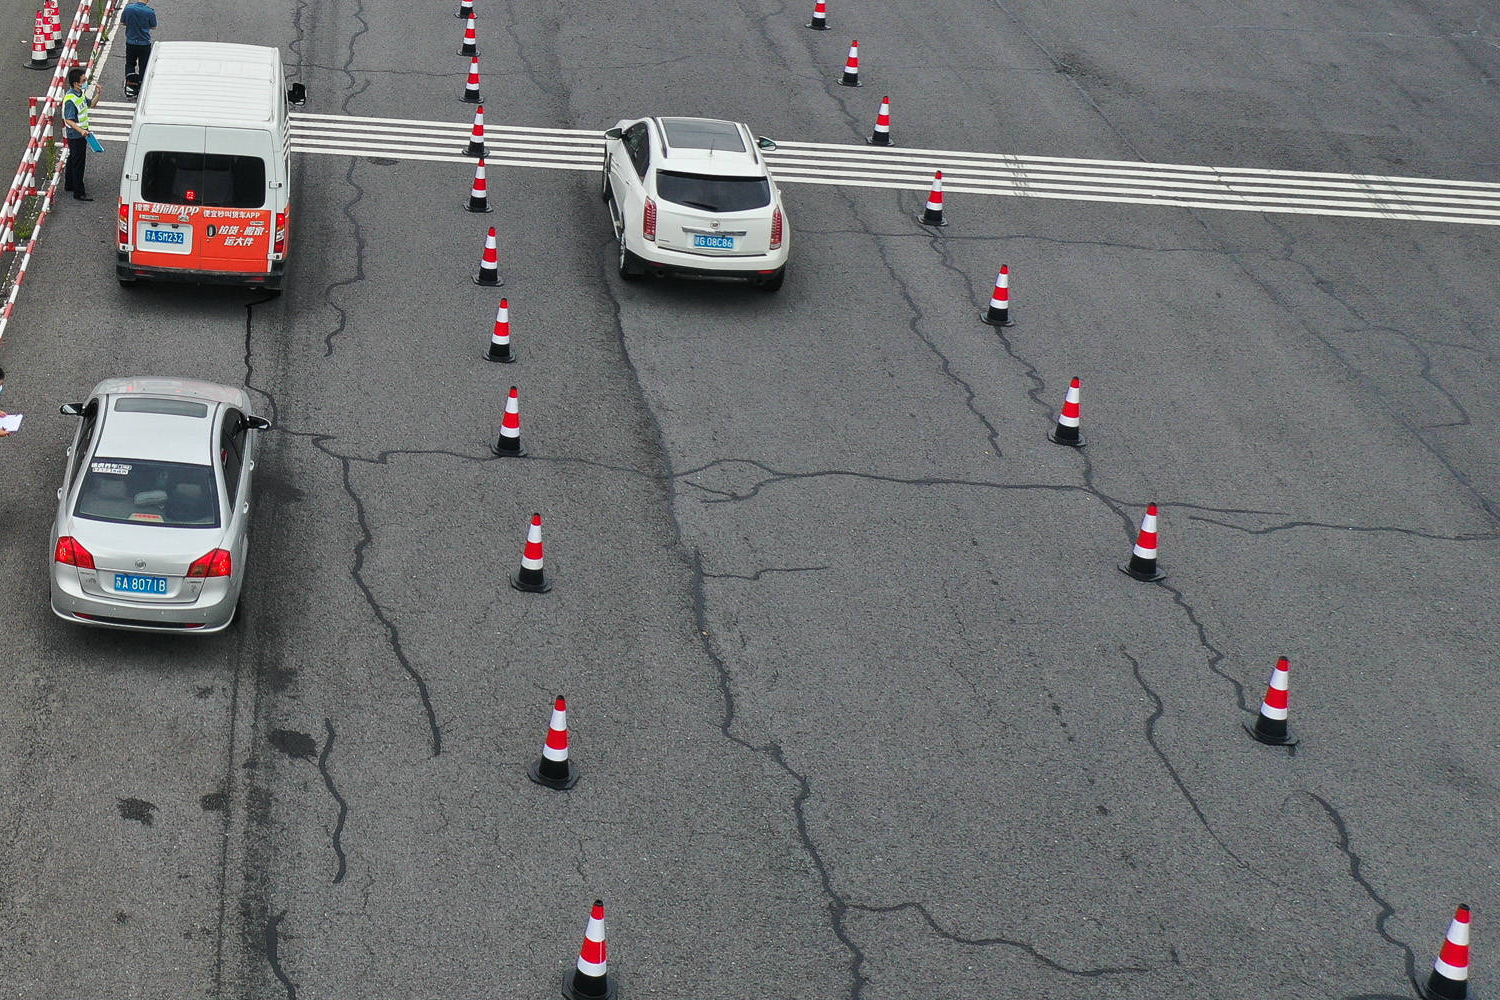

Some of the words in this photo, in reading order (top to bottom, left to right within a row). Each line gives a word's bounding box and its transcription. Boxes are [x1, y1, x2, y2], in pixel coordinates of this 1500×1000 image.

[150, 203, 199, 216] 货拉拉APP
[224, 236, 255, 247] 运大件
